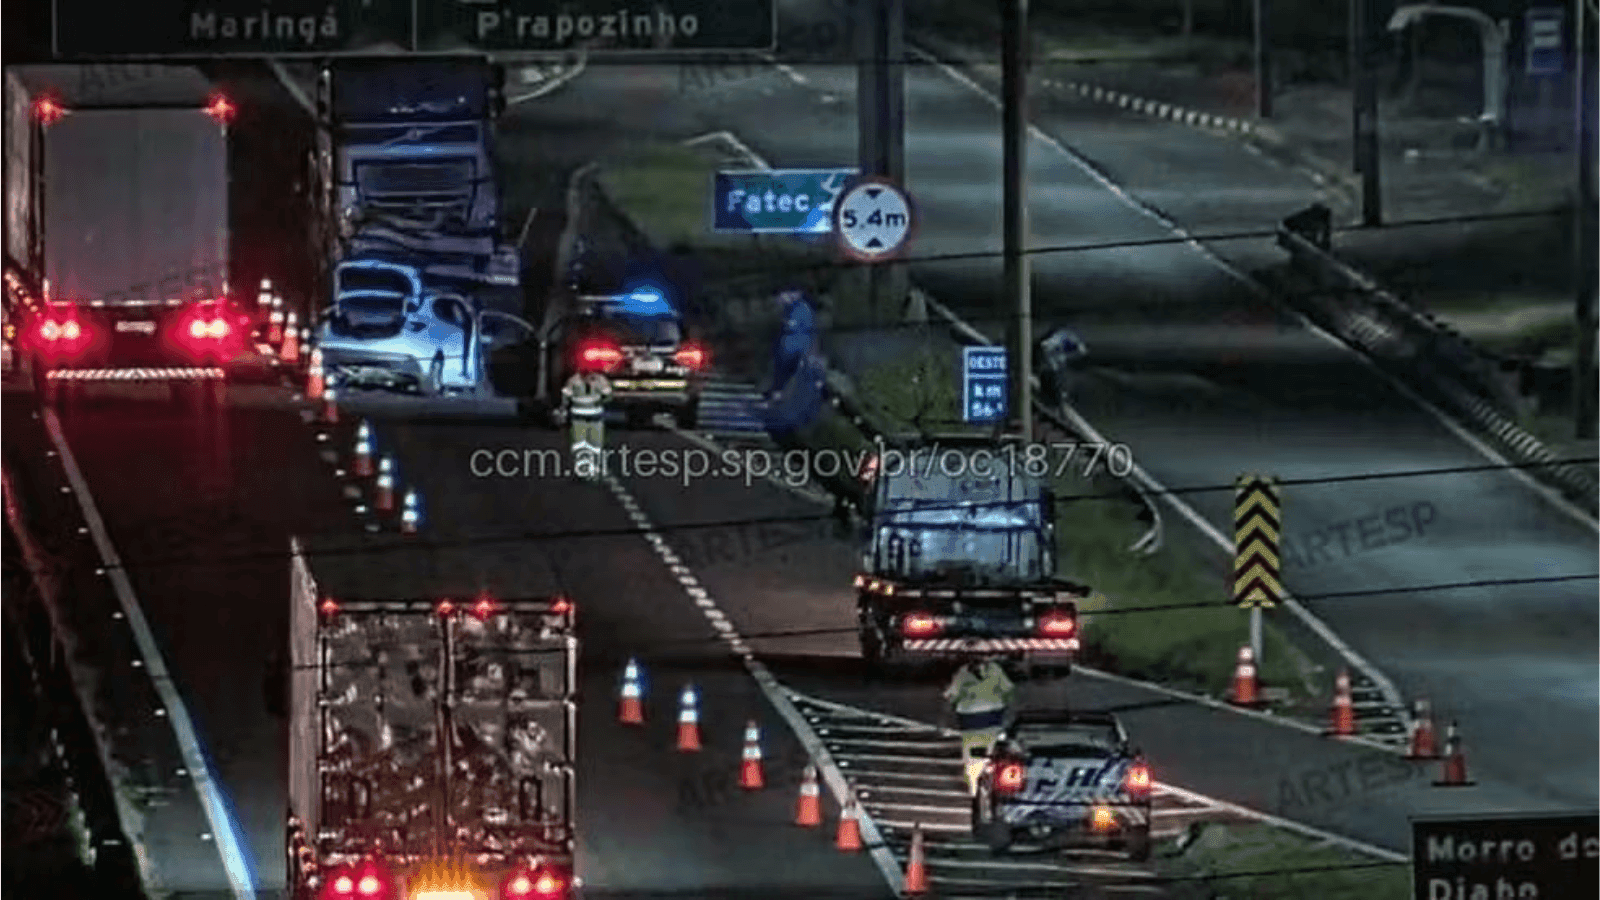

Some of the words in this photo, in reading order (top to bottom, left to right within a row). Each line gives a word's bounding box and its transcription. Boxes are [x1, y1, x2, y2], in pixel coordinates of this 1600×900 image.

[190, 5, 338, 45] Maringá
[728, 189, 810, 213] Fatec
[843, 208, 906, 229] 5.4m
[974, 384, 1001, 397] km
[1427, 835, 1536, 863] Morro
